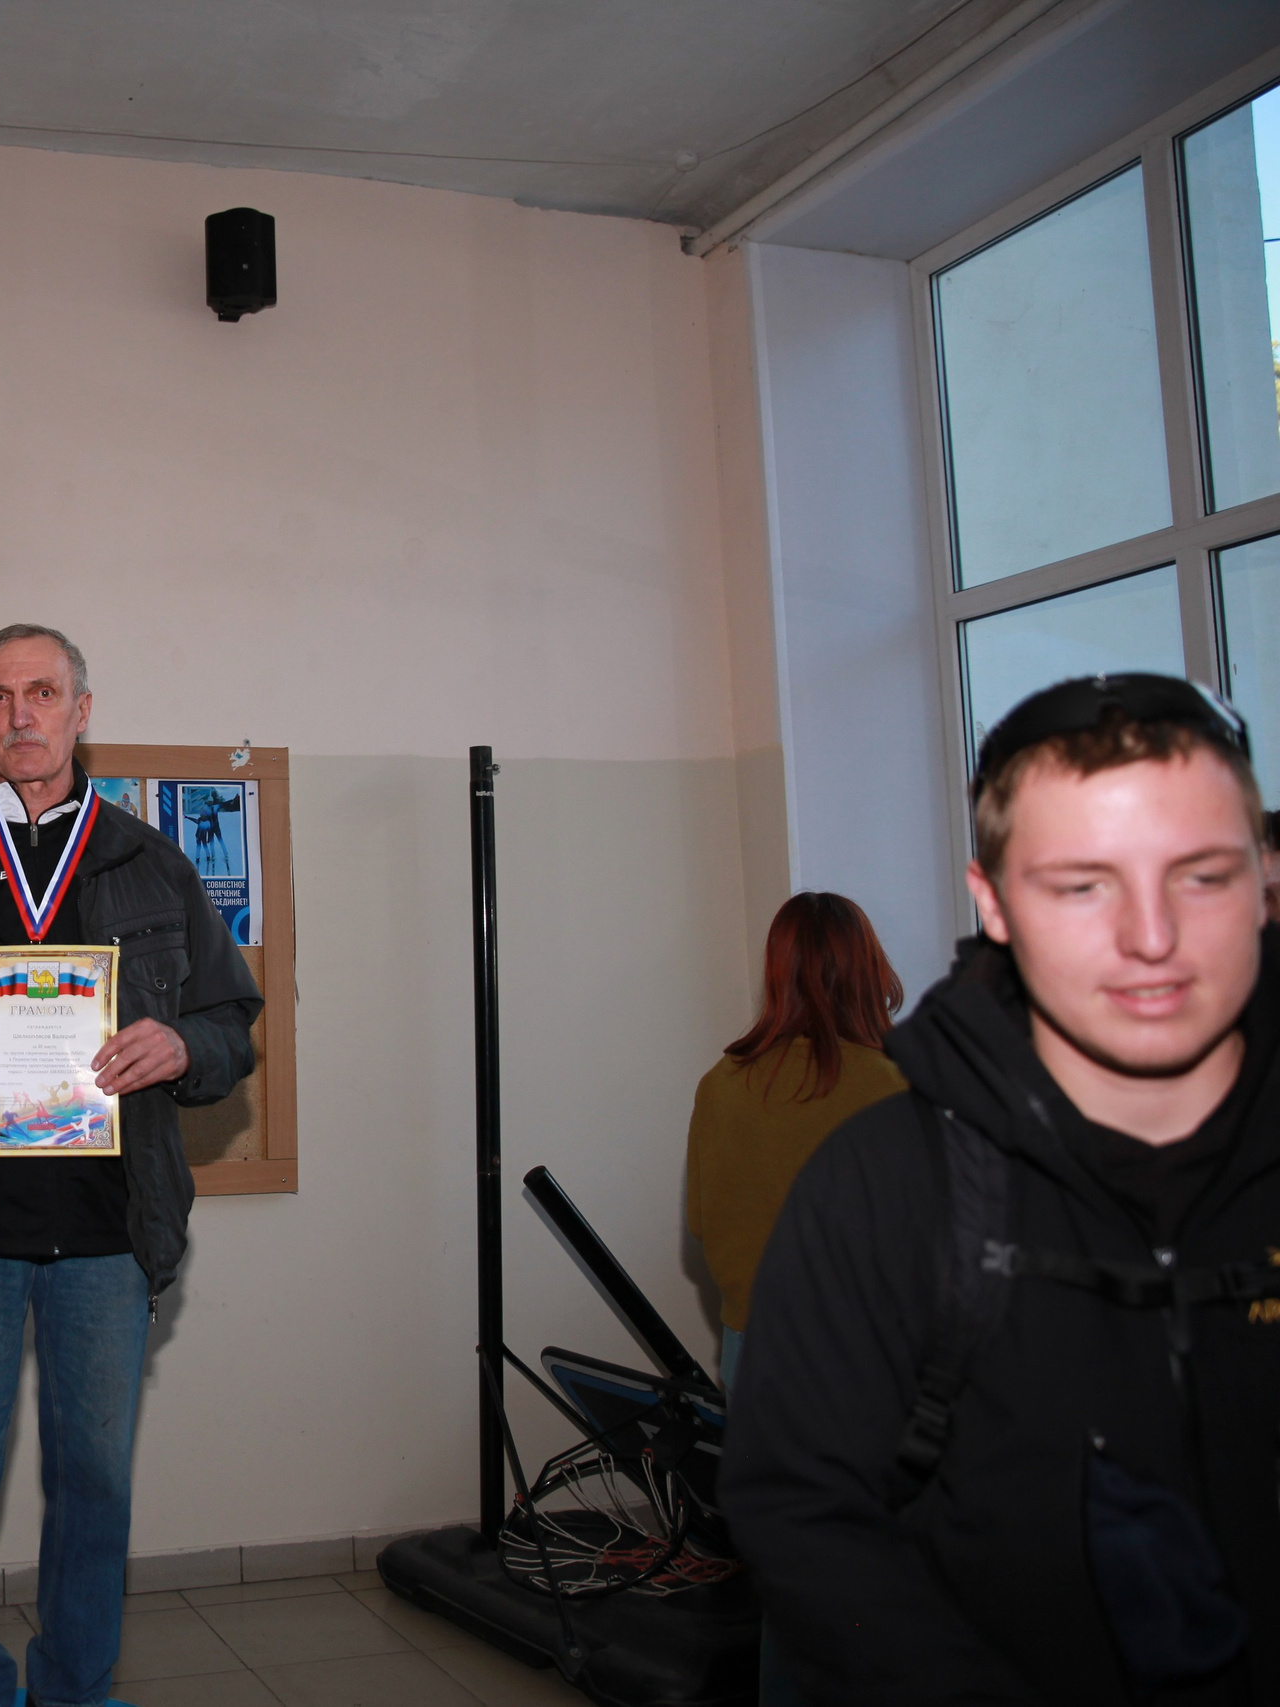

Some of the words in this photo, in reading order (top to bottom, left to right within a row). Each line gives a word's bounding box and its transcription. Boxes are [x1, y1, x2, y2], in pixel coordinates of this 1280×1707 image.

[206, 881, 246, 889] СОВМЕСТНОЕ
[211, 898, 248, 906] БЪЕДИНЯЕТ!
[10, 1005, 74, 1015] ГРАМОТА
